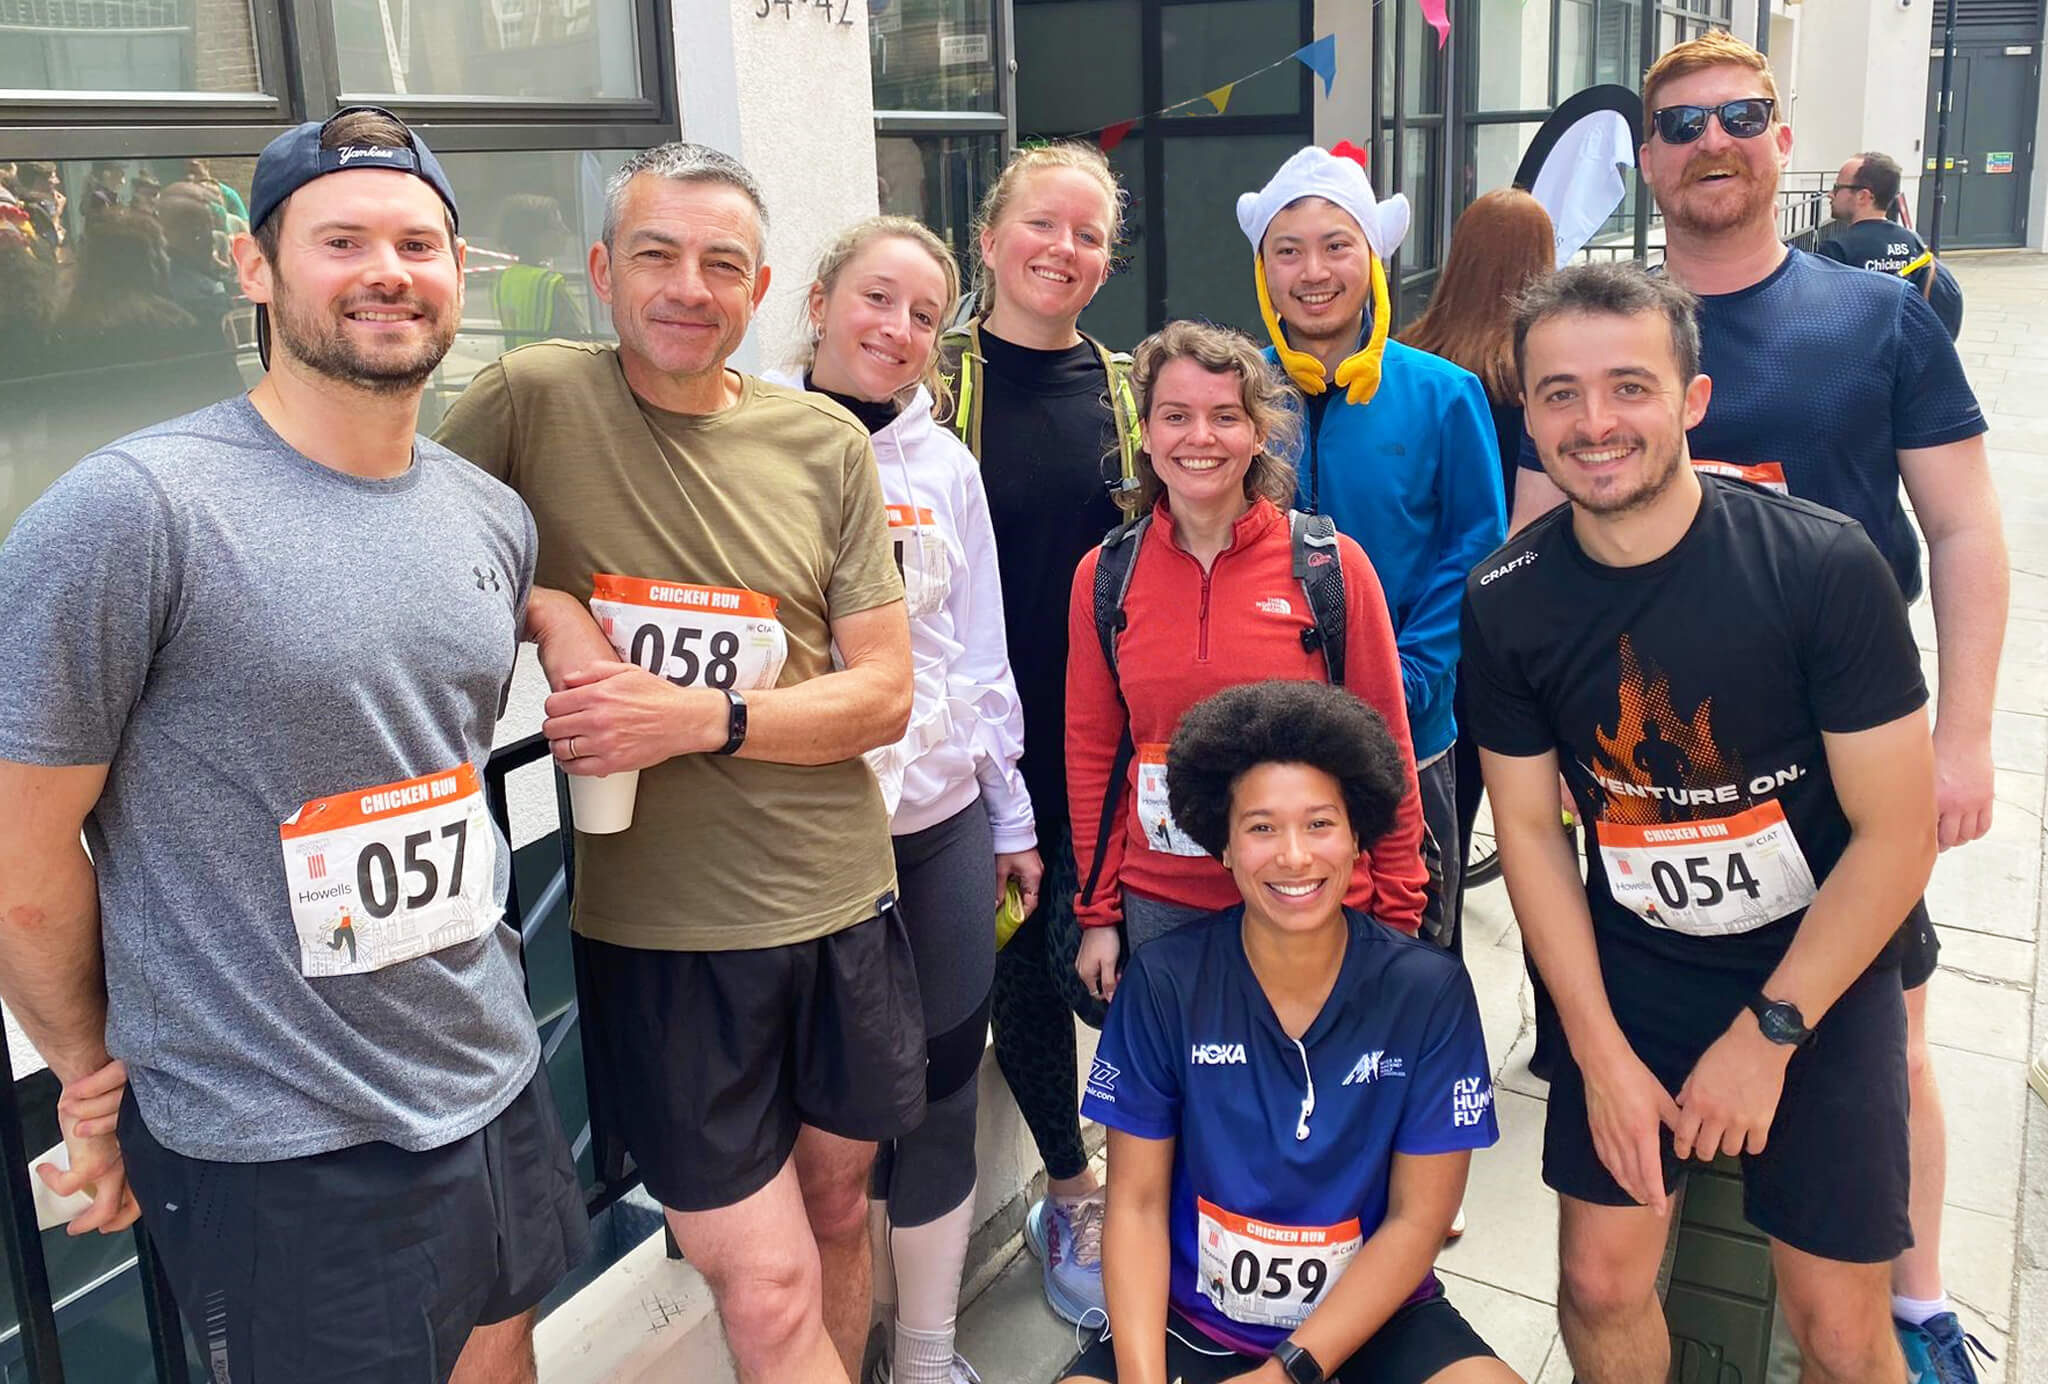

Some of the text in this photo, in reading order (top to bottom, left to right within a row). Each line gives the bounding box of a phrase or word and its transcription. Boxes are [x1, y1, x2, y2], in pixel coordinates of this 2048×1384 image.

[337, 145, 393, 165] Yankees
[1887, 243, 1910, 256] ABS
[1865, 257, 1908, 271] Chicken
[1480, 555, 1525, 586] CRAFT
[649, 586, 741, 609] CHICKEN RUN
[630, 623, 740, 690] 058
[360, 777, 457, 815] CHICKEN RUN
[1584, 764, 1807, 806] VENTURE ON.
[1643, 823, 1729, 843] CHICKEN RUN
[356, 818, 468, 919] 057
[1650, 852, 1760, 910] 054
[298, 882, 353, 904] Howells
[1191, 1044, 1247, 1065] HOKA
[1454, 1077, 1481, 1095] FLY
[1454, 1109, 1483, 1127] FLY
[1246, 1221, 1327, 1243] CHICKEN RUN
[1230, 1249, 1328, 1304] 059
